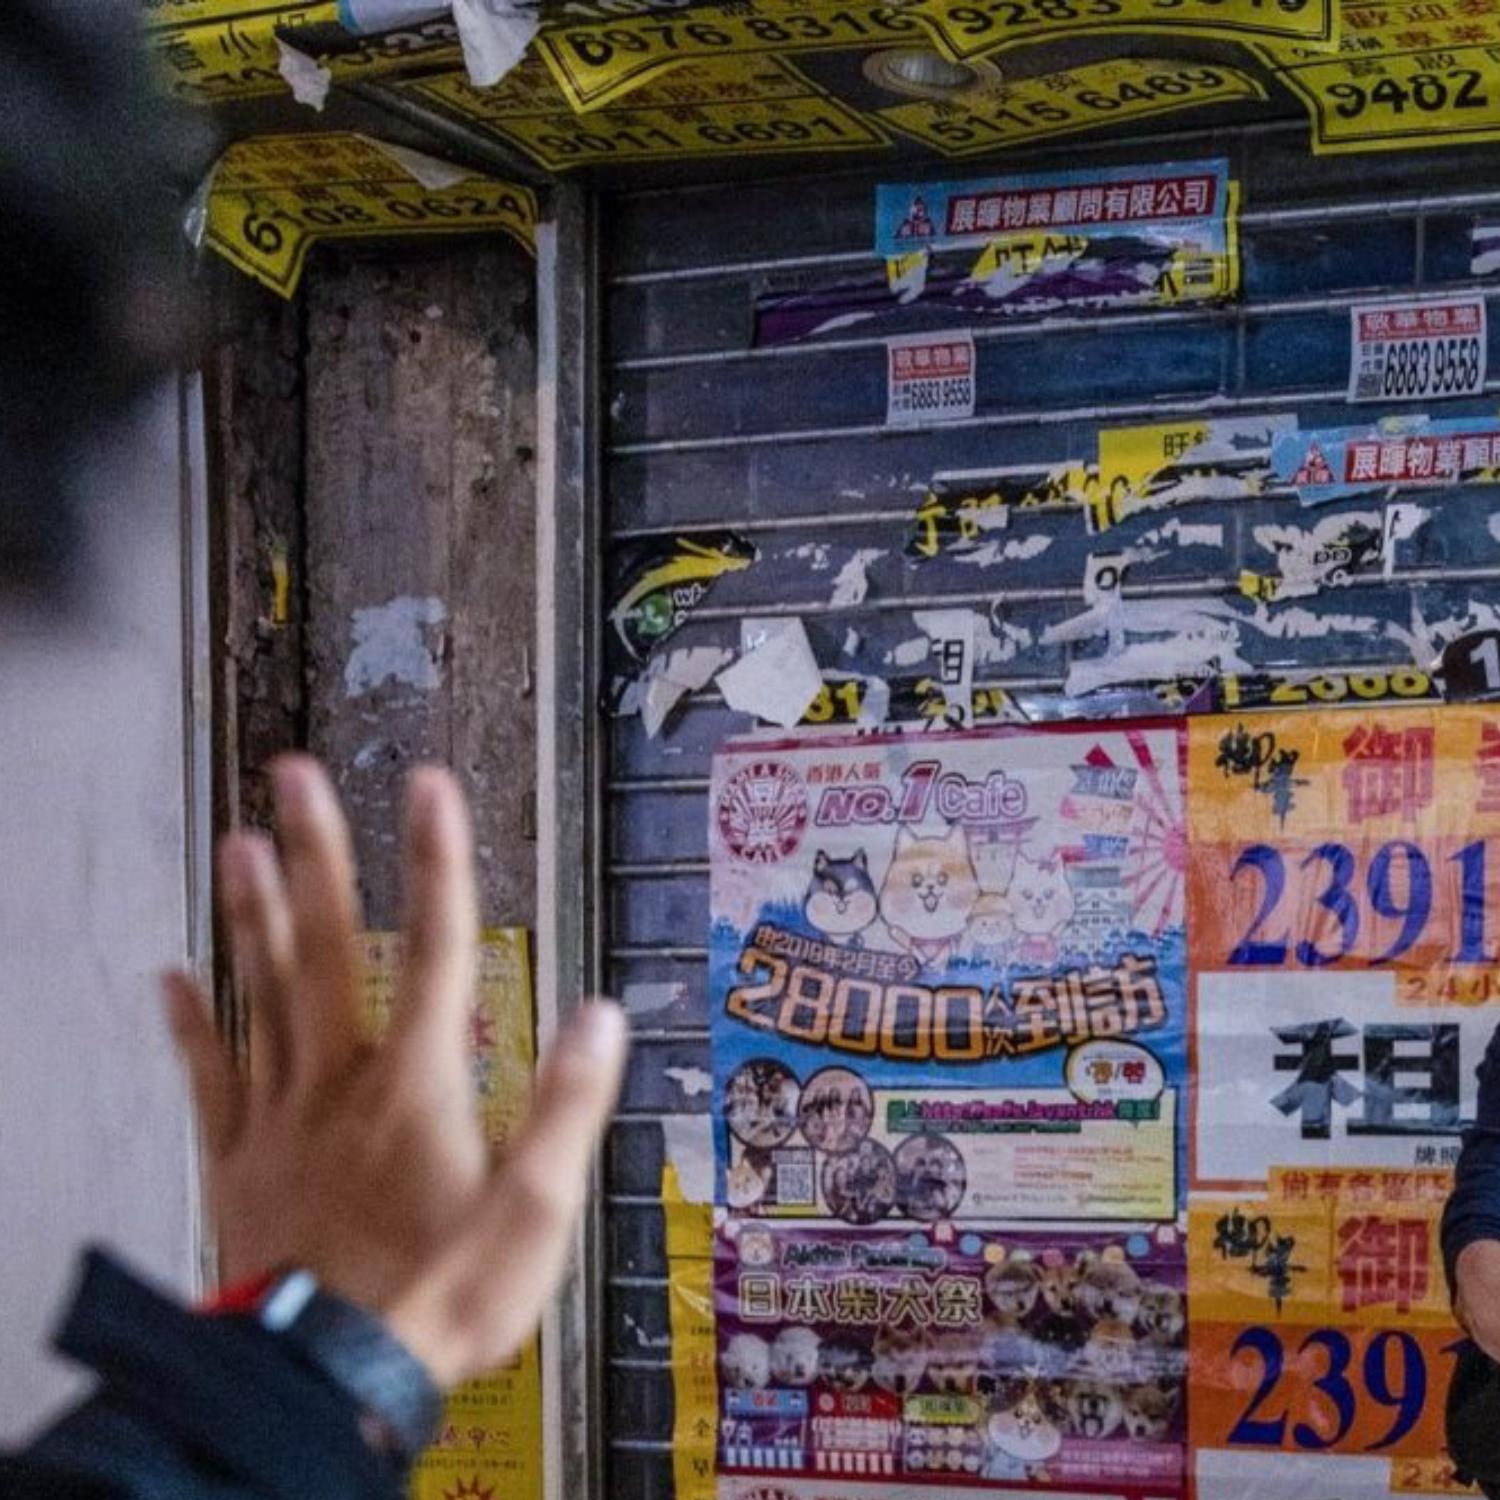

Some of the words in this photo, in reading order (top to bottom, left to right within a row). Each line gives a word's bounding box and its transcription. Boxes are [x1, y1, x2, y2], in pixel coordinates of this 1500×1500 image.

[568, 20, 732, 66] 6976
[1383, 340, 1431, 396] 6883
[1431, 337, 1480, 393] 9558
[937, 772, 1029, 821] Cafe
[1229, 840, 1499, 968] 2391
[1267, 1016, 1478, 1141] 租
[738, 1271, 981, 1324] 日本柴犬祭
[1227, 1325, 1471, 1451] 239
